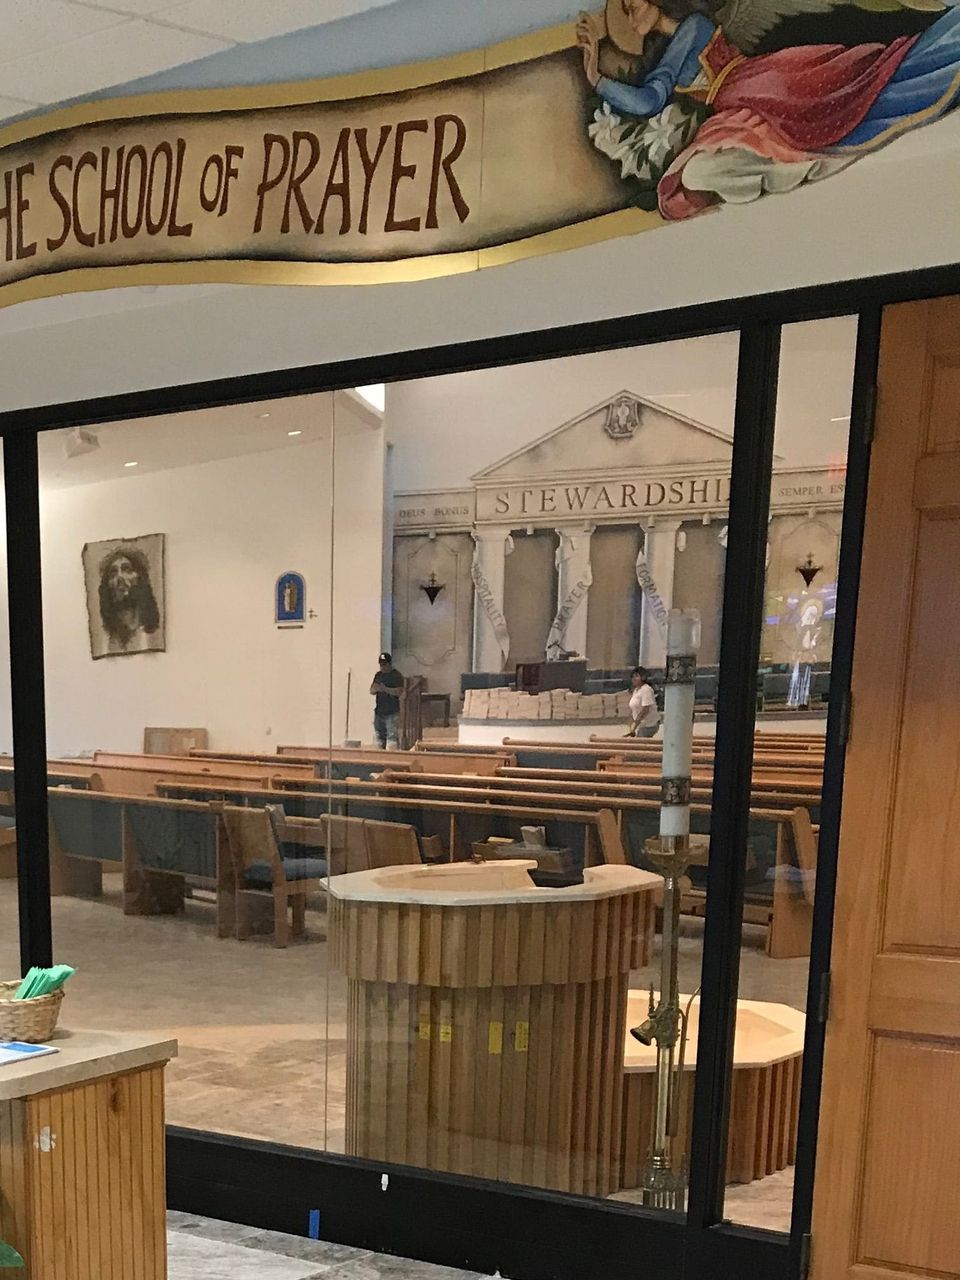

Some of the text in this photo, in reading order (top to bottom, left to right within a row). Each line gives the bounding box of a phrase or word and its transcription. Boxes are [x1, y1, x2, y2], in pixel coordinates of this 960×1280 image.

[46, 138, 193, 251] SCHOOL
[200, 145, 245, 217] OF
[253, 114, 470, 236] PRAYER
[399, 505, 470, 519] DEUS BONUS
[495, 477, 730, 515] STEWARDSHI
[778, 483, 844, 497] SEMPER ES
[472, 562, 506, 628] HOSPITALITY
[553, 580, 588, 632] PRAYER
